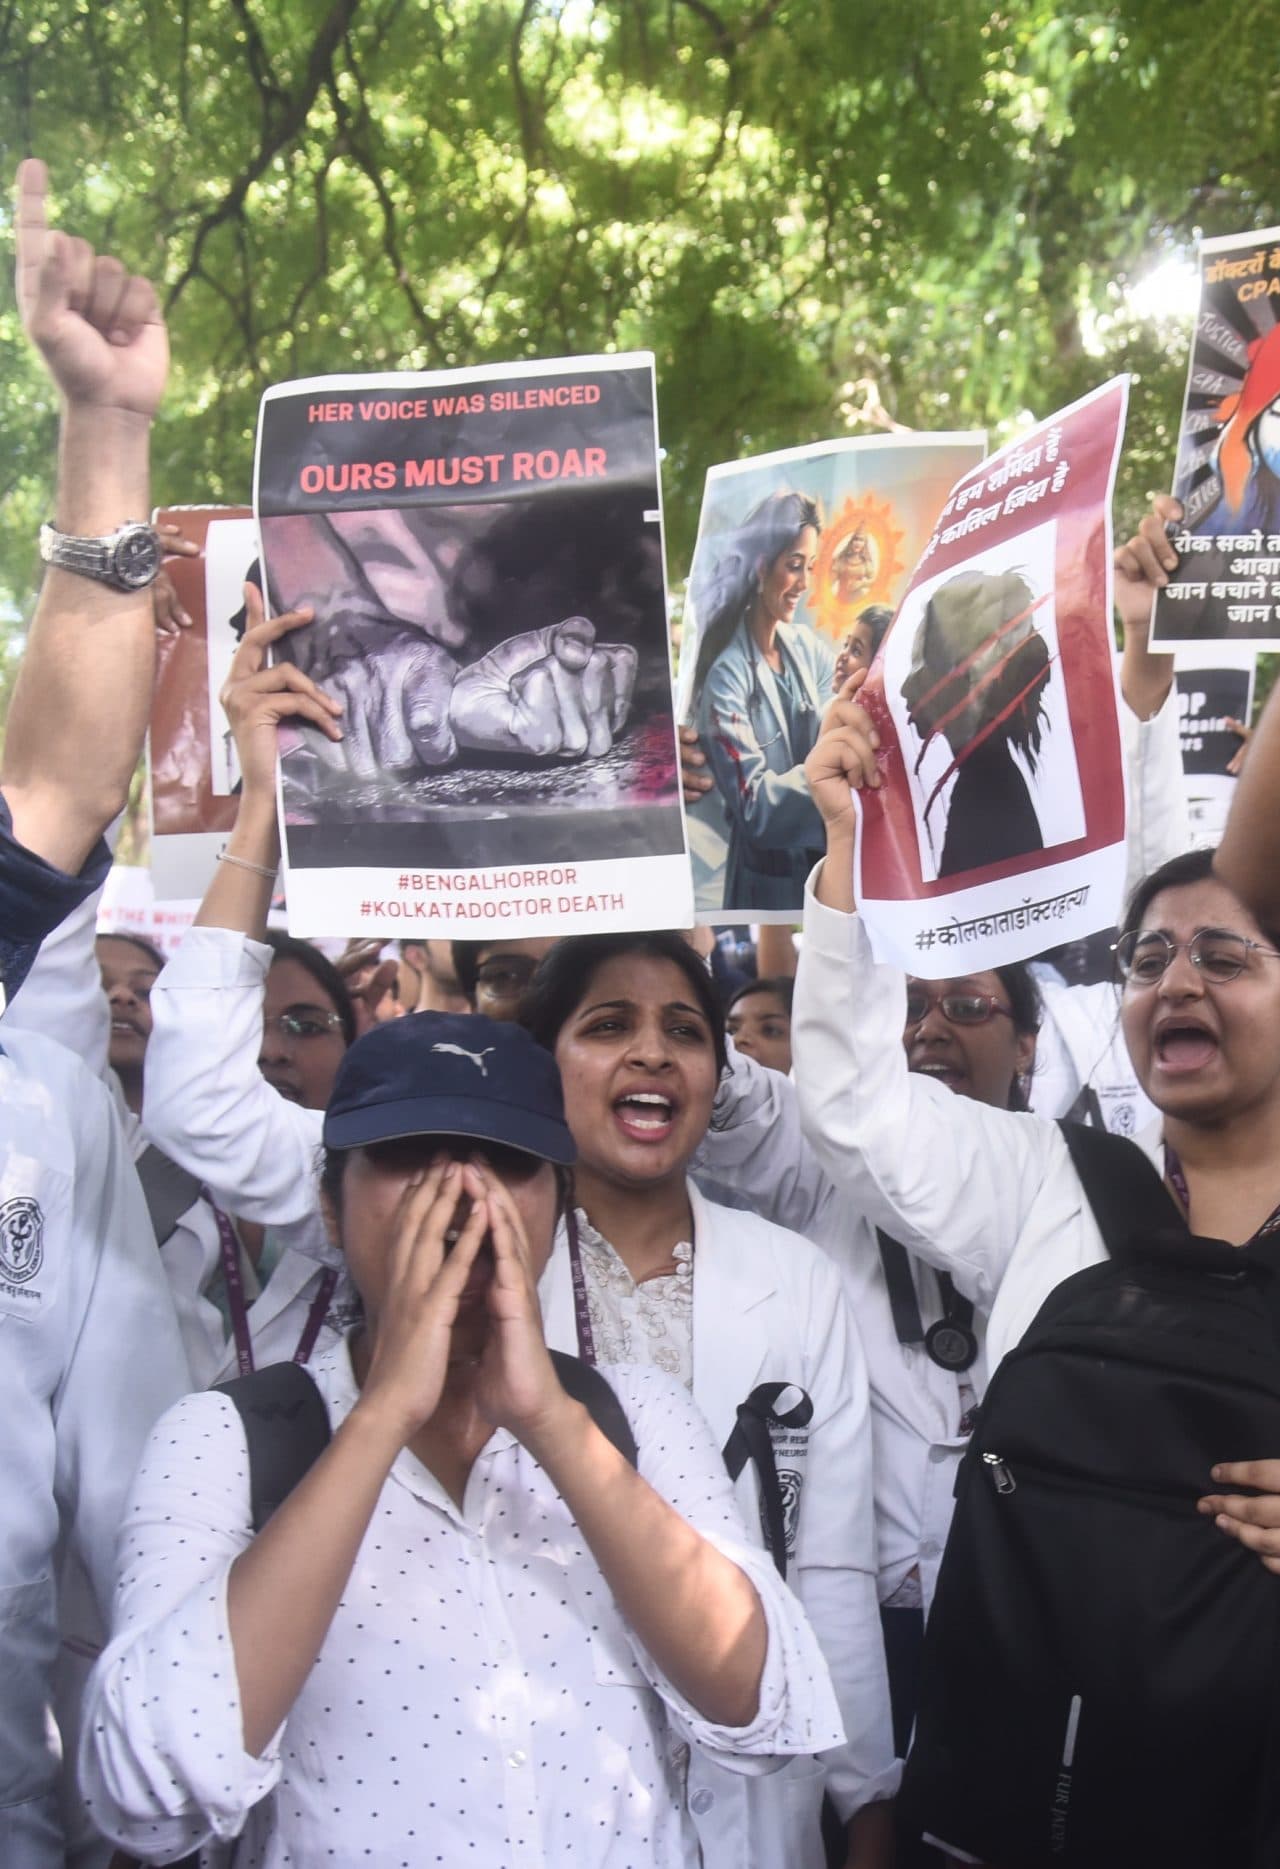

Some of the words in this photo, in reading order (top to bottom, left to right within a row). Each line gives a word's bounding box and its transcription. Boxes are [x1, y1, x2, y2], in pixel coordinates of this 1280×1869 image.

[1237, 279, 1280, 303] CPA
[308, 403, 353, 423] HER
[358, 400, 427, 421] VOICE
[433, 394, 486, 417] WAS
[490, 384, 602, 412] SILENCED
[300, 462, 396, 493] OURS
[404, 455, 504, 487] MUST
[512, 447, 607, 481] ROAR
[1174, 530, 1213, 553] रोक
[1216, 529, 1264, 552] सको
[1165, 581, 1208, 599] जान
[1227, 604, 1272, 622] जान
[398, 868, 577, 891] #BENGALHORROR
[360, 898, 552, 918] #KOLKATADOCTOR
[558, 893, 624, 913] DEATH
